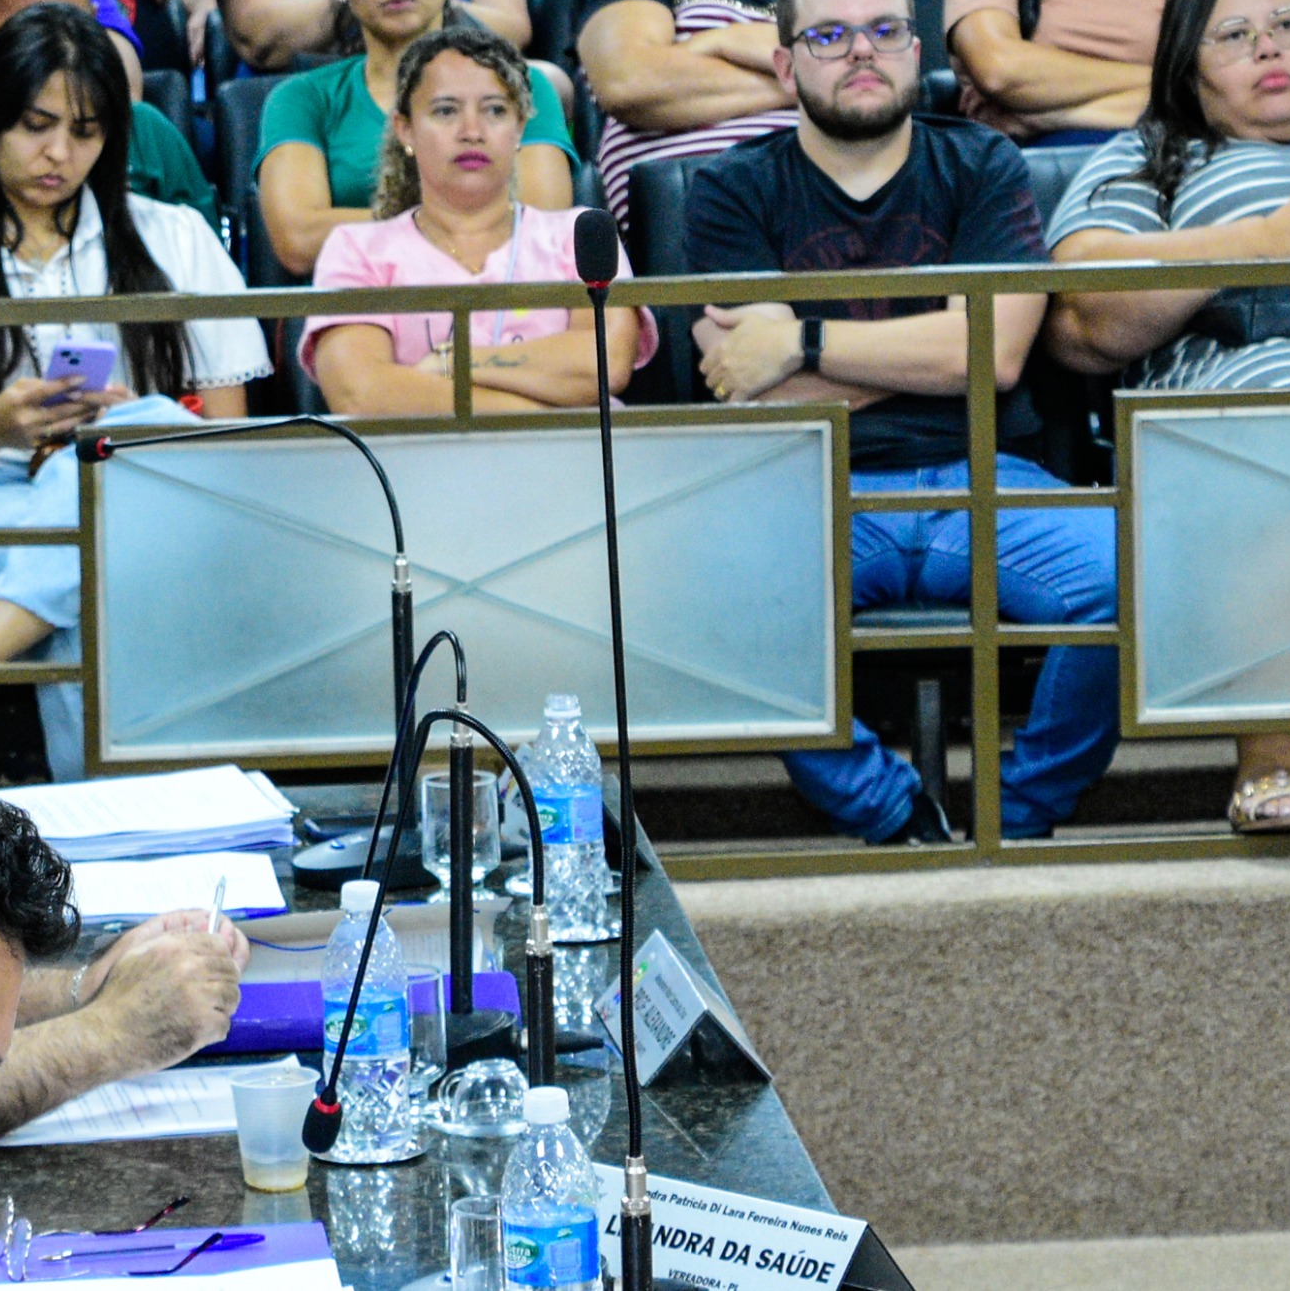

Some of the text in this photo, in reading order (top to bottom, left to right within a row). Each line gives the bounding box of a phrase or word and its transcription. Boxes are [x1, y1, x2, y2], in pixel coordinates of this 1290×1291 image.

[669, 1193, 708, 1211] Patrícia
[710, 1202, 722, 1214] Di
[722, 1205, 746, 1219] Lara
[747, 1211, 788, 1228] Ferreira
[789, 1220, 823, 1236] Nunes
[824, 1228, 849, 1242] Reis
[669, 1269, 721, 1289] VEREADORA
[720, 1237, 752, 1266] DA
[755, 1248, 836, 1284] SAÚDE
